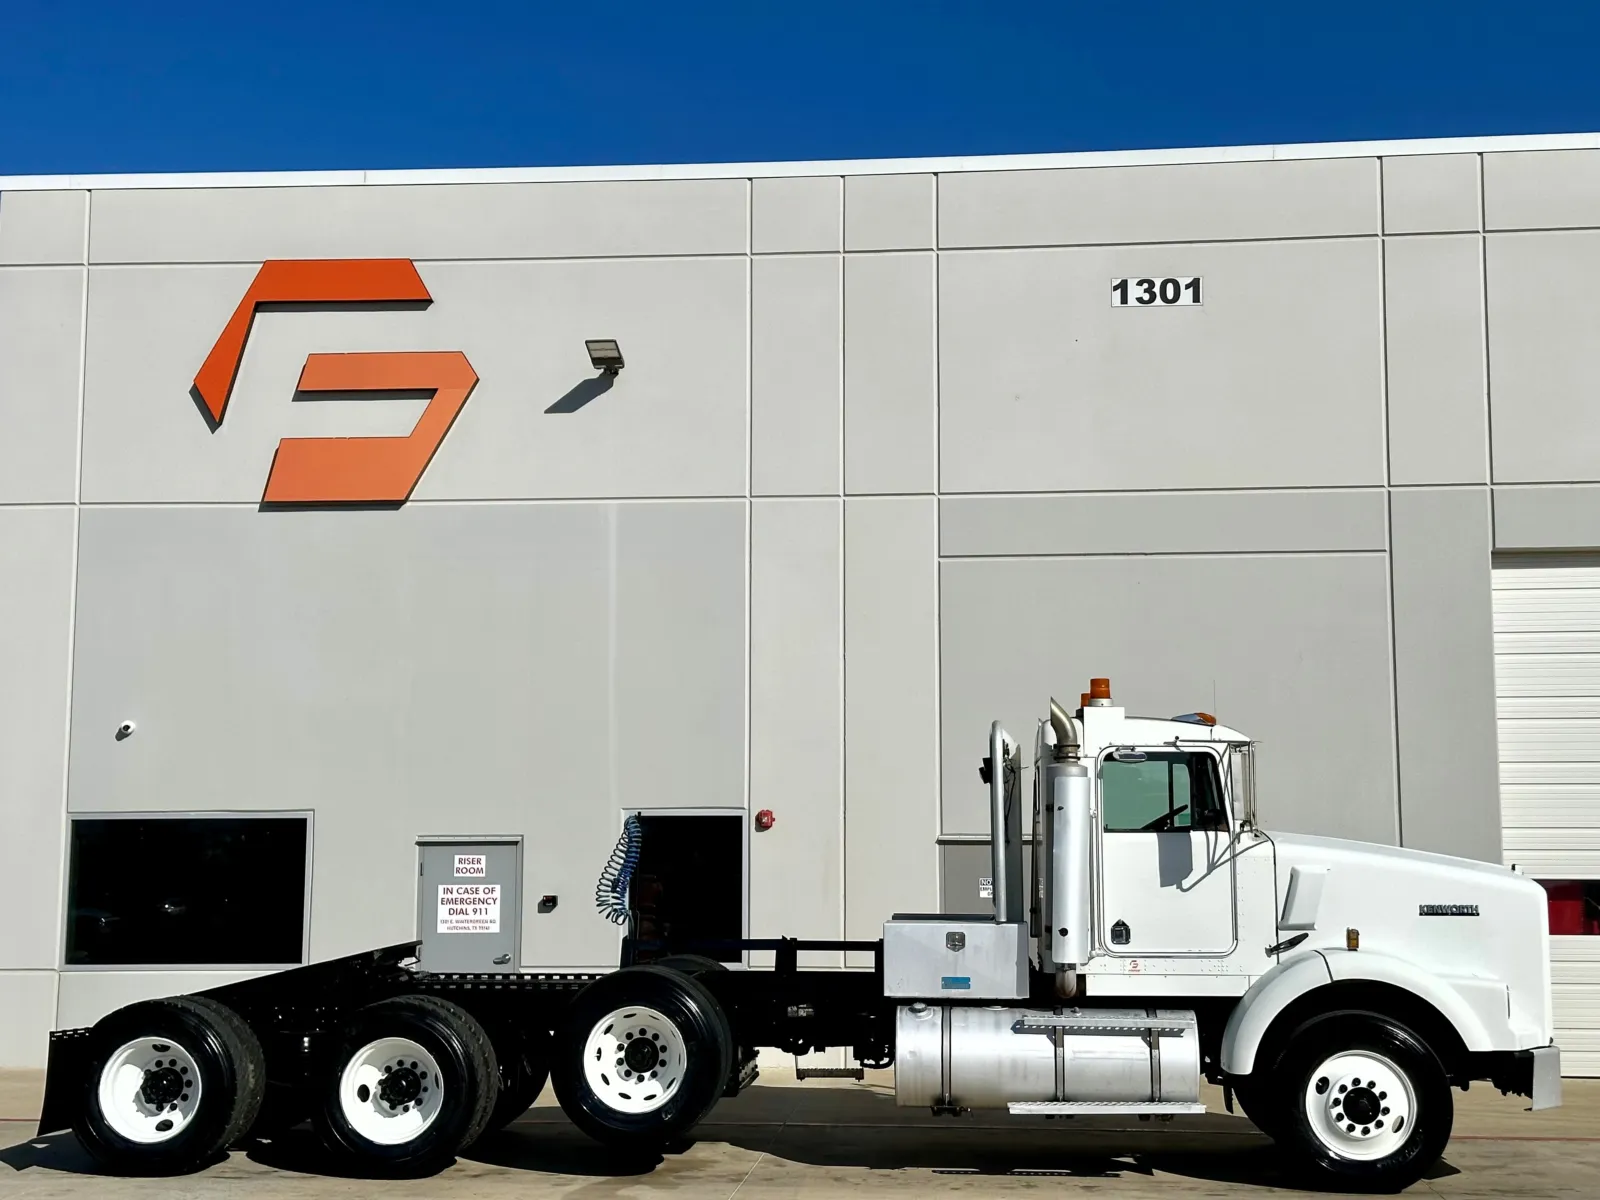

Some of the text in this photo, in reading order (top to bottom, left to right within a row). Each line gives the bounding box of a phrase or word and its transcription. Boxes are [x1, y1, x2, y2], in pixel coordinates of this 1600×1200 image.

[1113, 278, 1201, 305] 1301
[458, 857, 482, 865] RISER
[455, 867, 484, 875] ROOM
[443, 887, 496, 895] IN CASE OF
[440, 897, 498, 905] EMERGENCY
[448, 907, 488, 916] DIAL 911
[1419, 904, 1479, 916] KENWORTH
